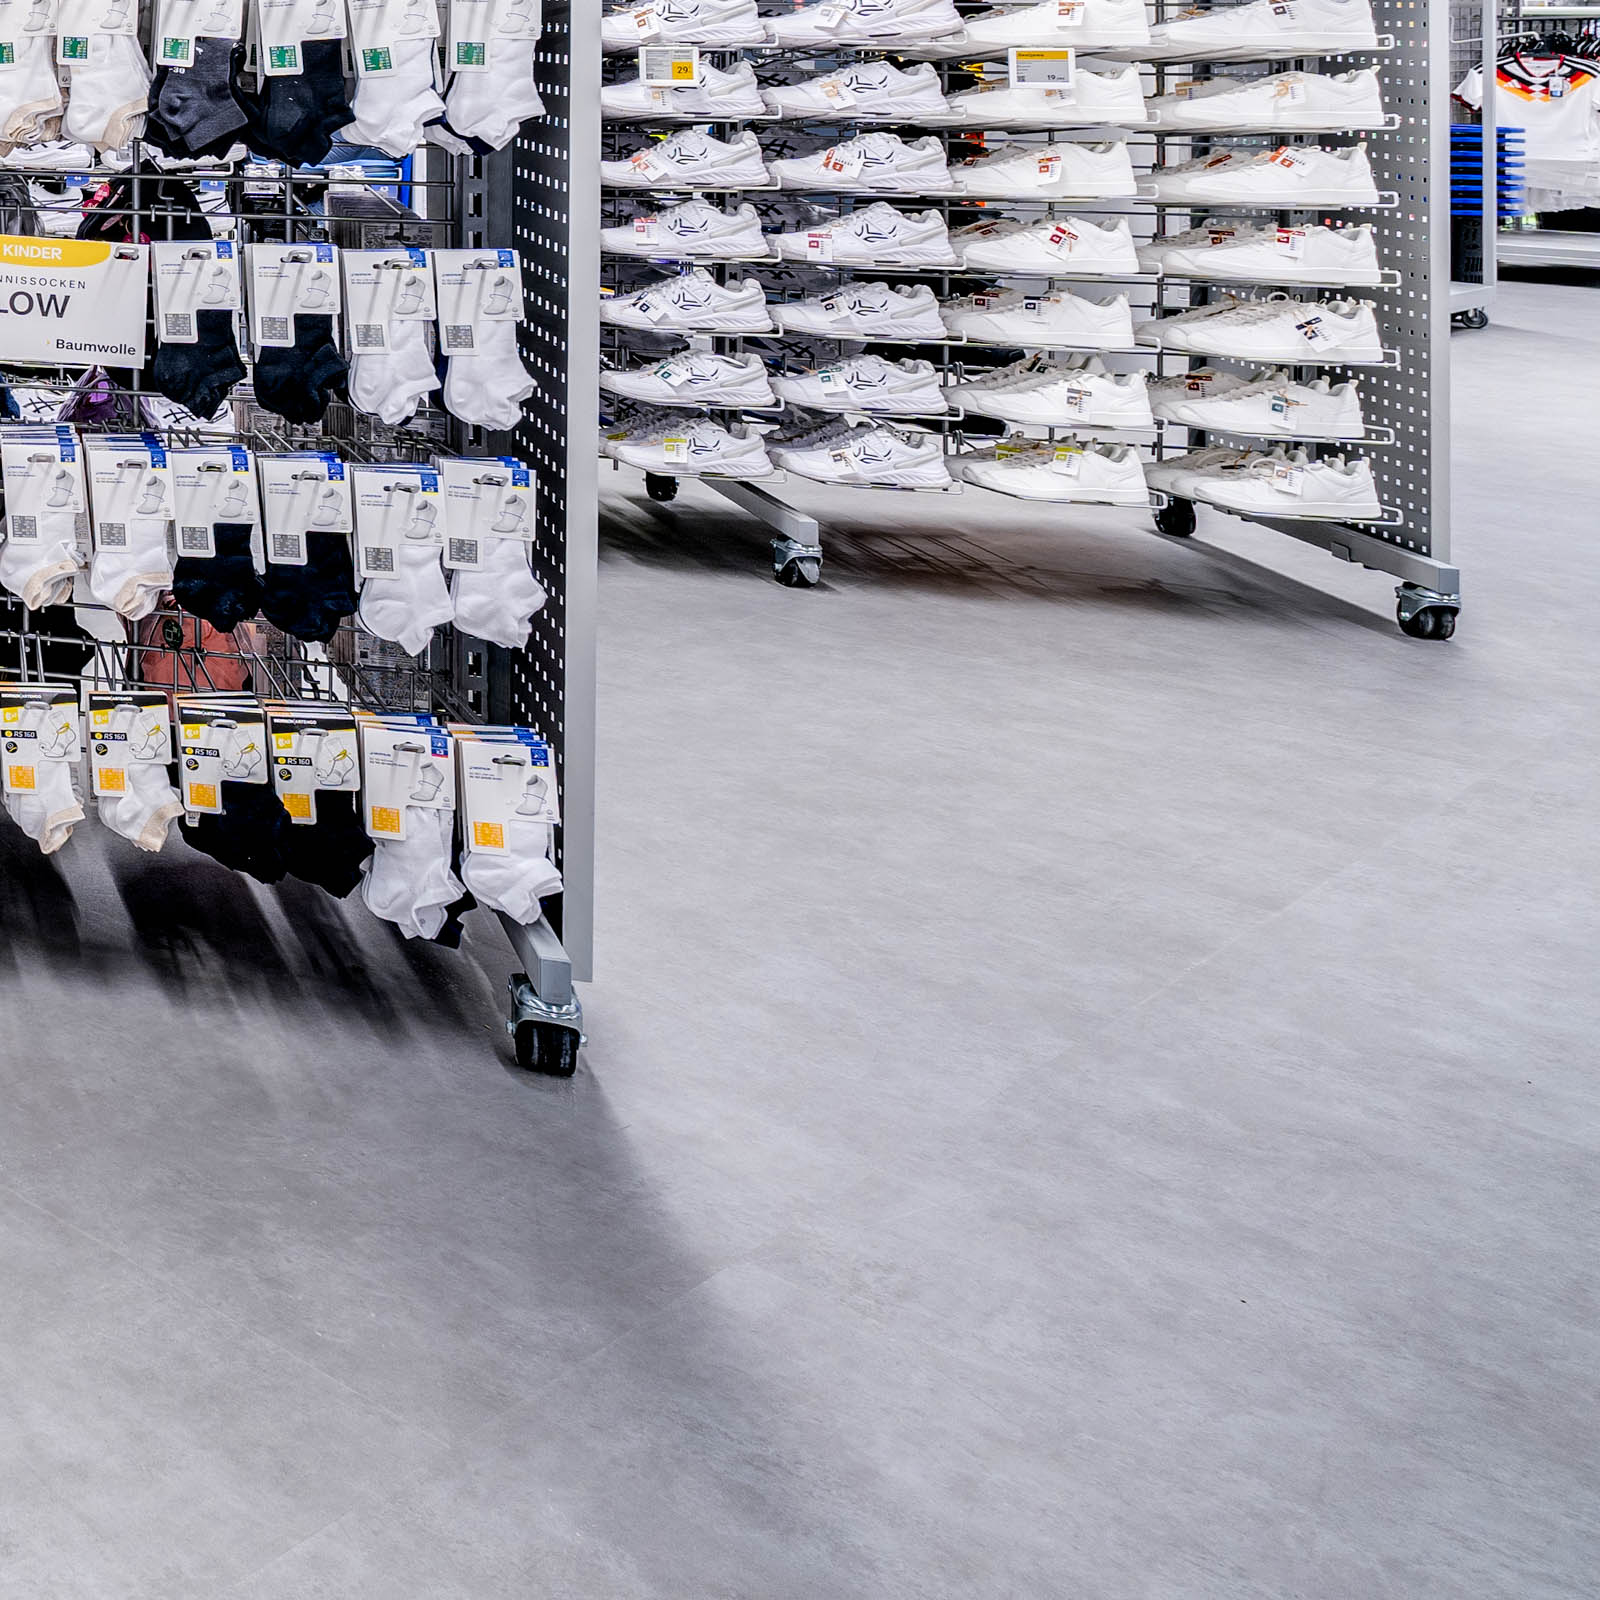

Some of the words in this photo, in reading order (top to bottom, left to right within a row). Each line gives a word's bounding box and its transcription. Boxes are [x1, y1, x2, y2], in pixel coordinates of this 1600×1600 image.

[3, 244, 62, 261] KINDER
[56, 338, 136, 356] Baumwolle
[205, 748, 218, 756] 160
[298, 758, 310, 766] 160
